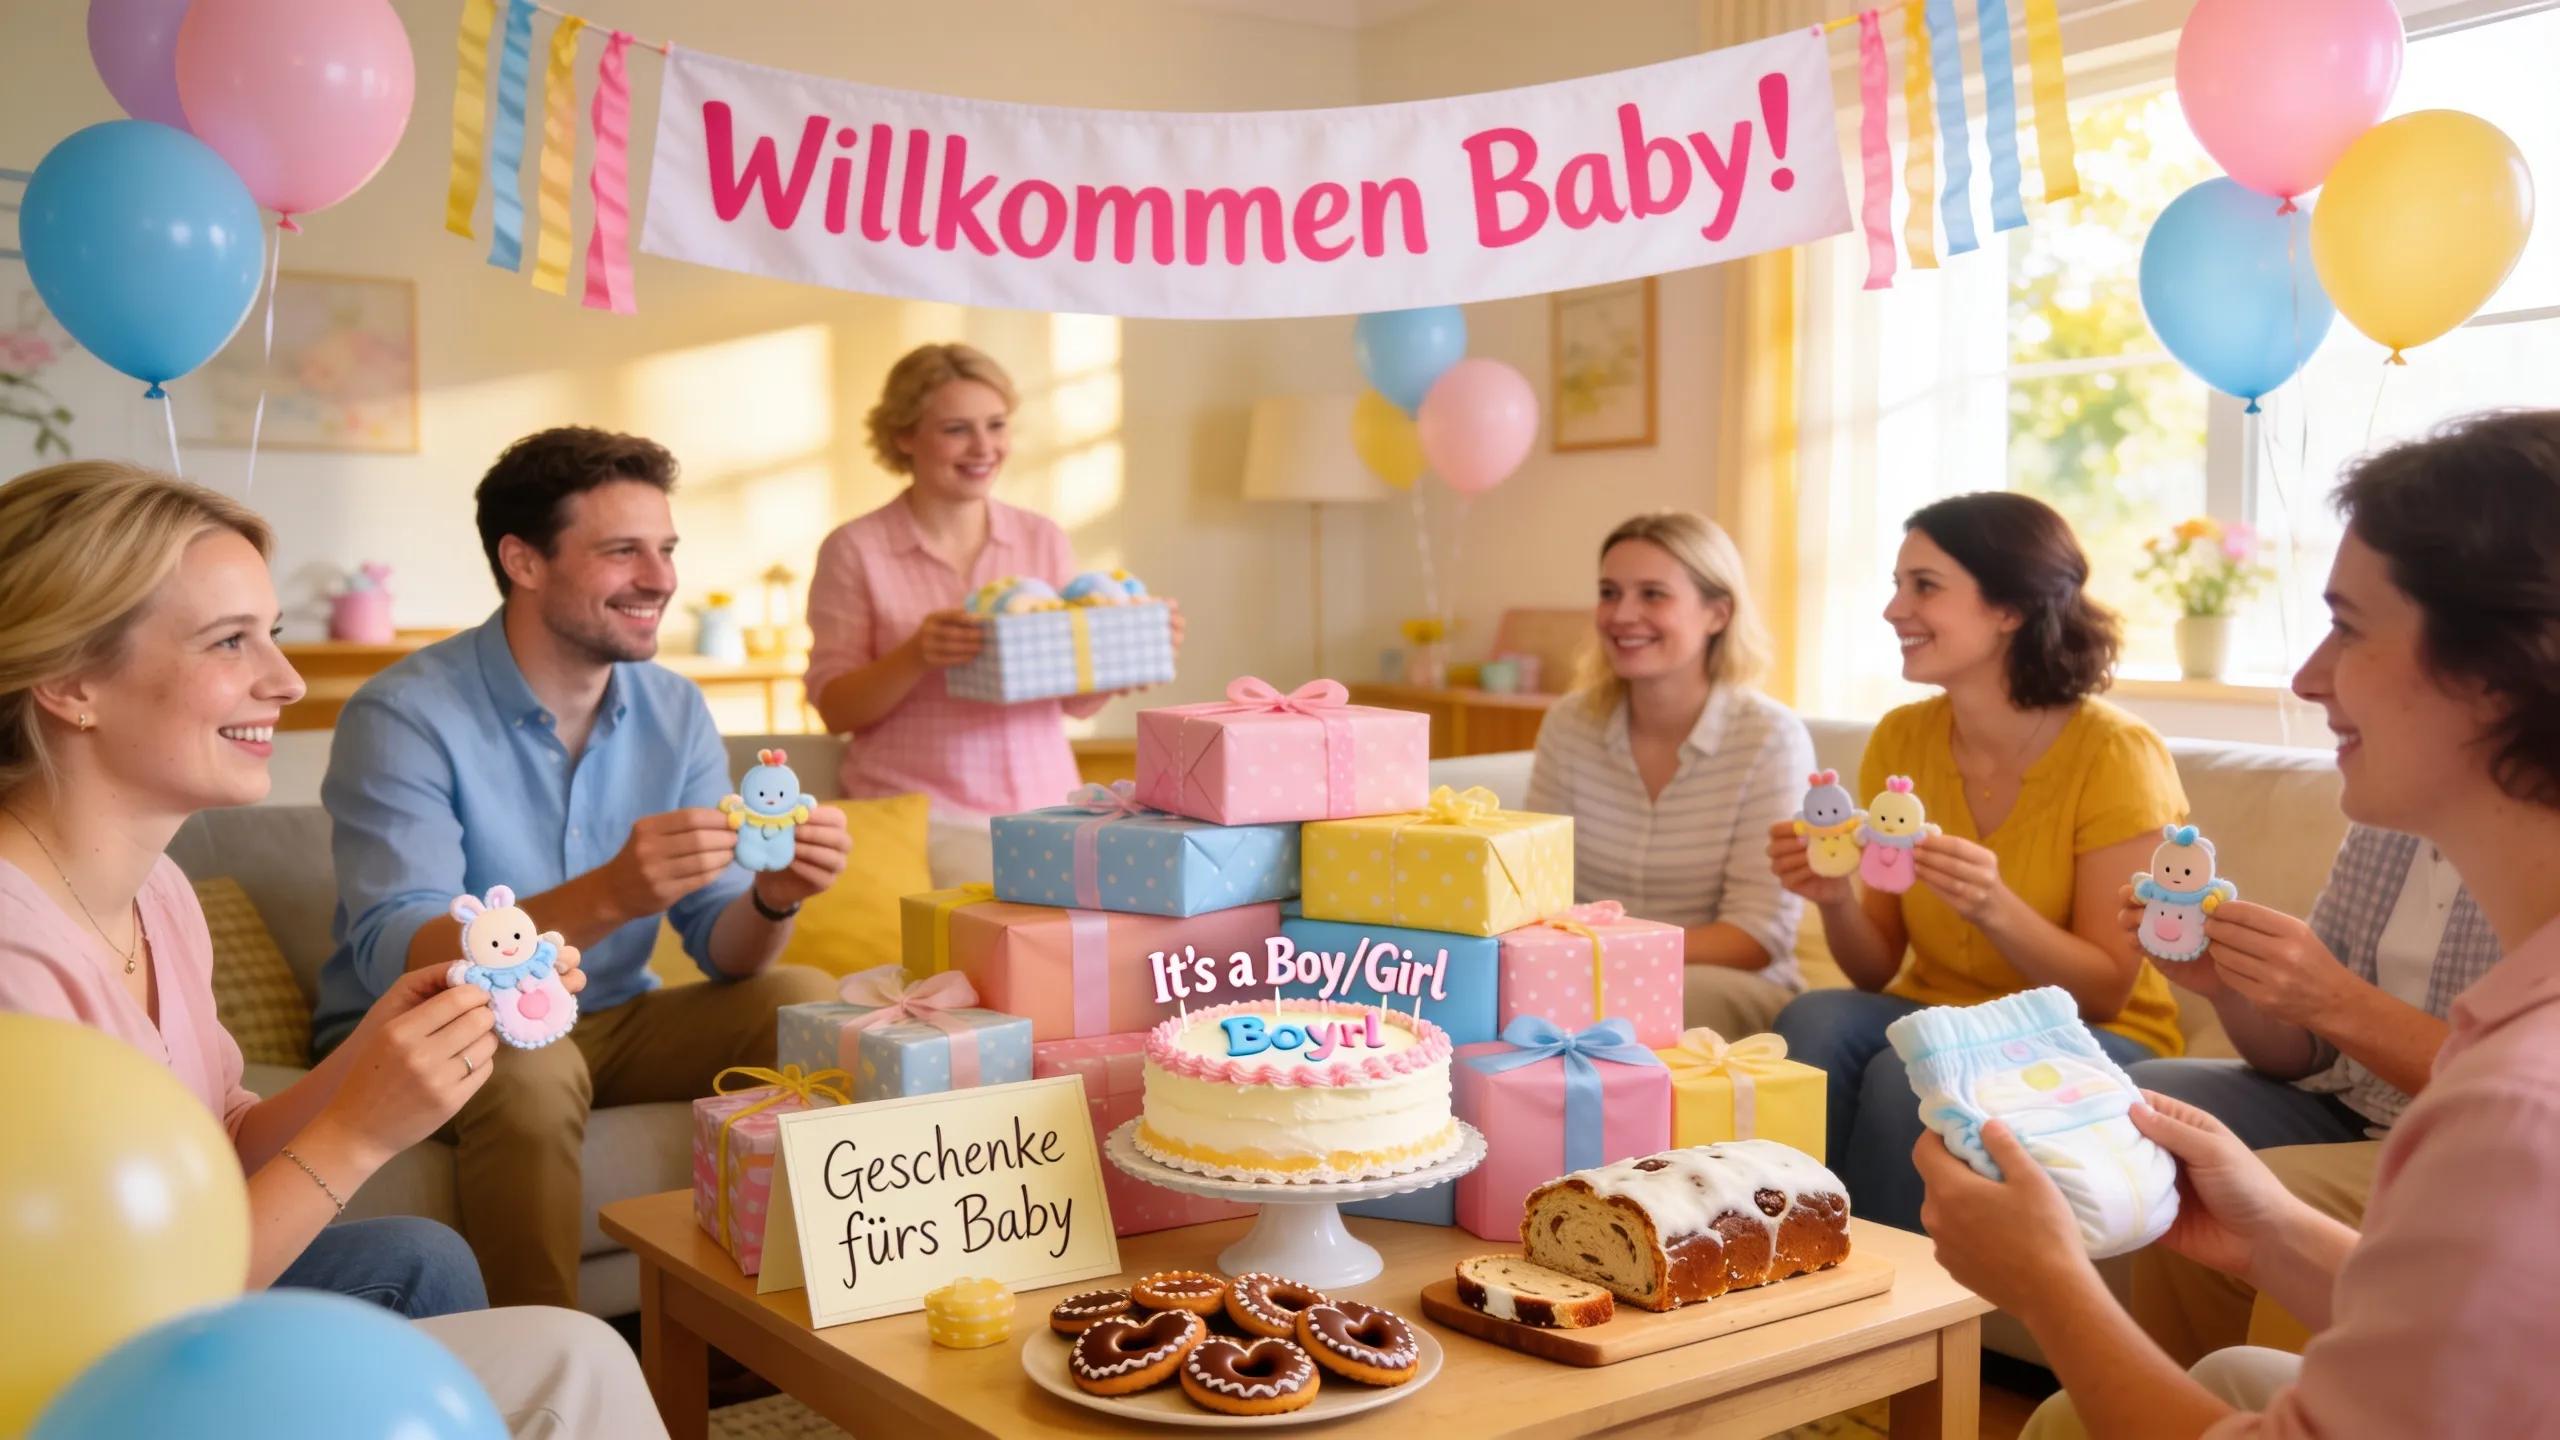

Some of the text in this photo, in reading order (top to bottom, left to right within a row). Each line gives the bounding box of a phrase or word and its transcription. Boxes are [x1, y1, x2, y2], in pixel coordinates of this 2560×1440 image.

[702, 72, 1795, 265] Willkommen Baby!
[1148, 936, 1448, 1003] It's a Boy/Girl
[824, 1115, 1066, 1204] Geschenke
[838, 1183, 1073, 1289] fürs Baby
